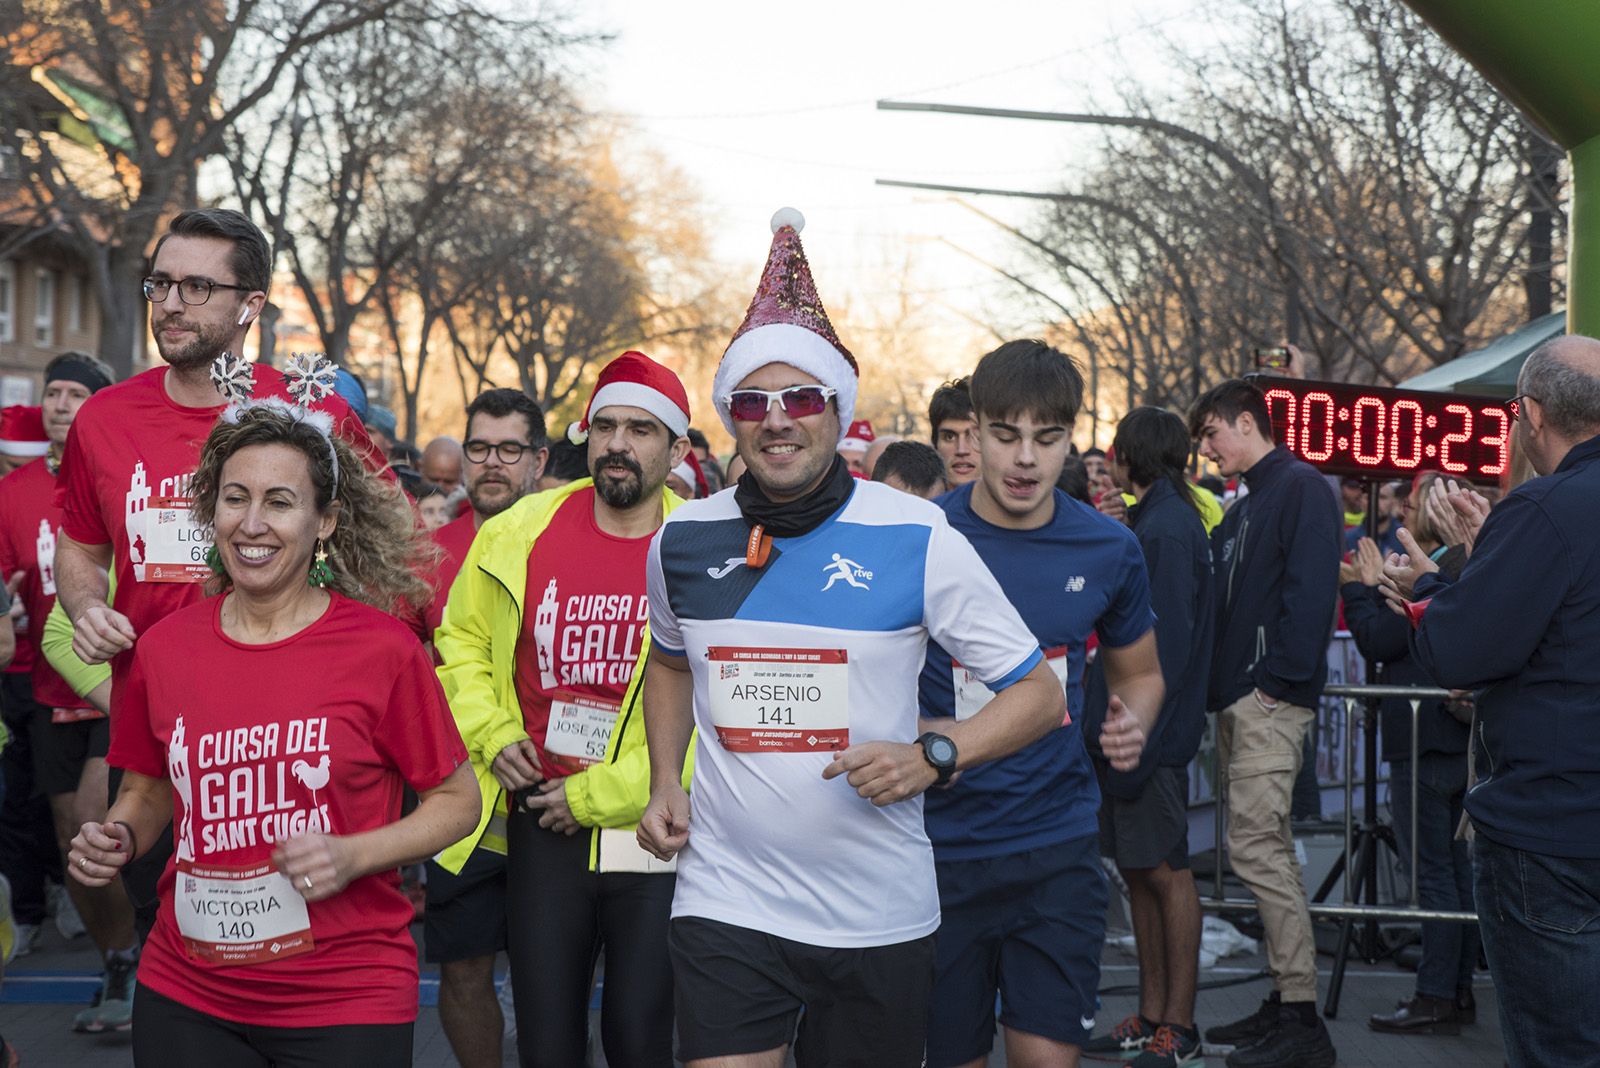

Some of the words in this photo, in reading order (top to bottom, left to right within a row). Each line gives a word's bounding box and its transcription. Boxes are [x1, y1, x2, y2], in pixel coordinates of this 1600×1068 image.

[854, 568, 873, 580] rtve
[565, 594, 633, 621] CURSA
[560, 624, 638, 662] GALL
[560, 661, 607, 685] SANT
[608, 662, 636, 684] CU
[731, 684, 821, 702] ARSENIO
[757, 706, 796, 725] 141
[553, 719, 589, 736] JOSE
[198, 722, 280, 769] CURSA
[285, 717, 330, 755] DEL
[585, 741, 606, 758] 53
[200, 761, 296, 821] GALL
[201, 817, 258, 855] SANT
[261, 804, 331, 844] CUGAT
[190, 896, 281, 917] VICTORIA
[218, 921, 255, 939] 140
